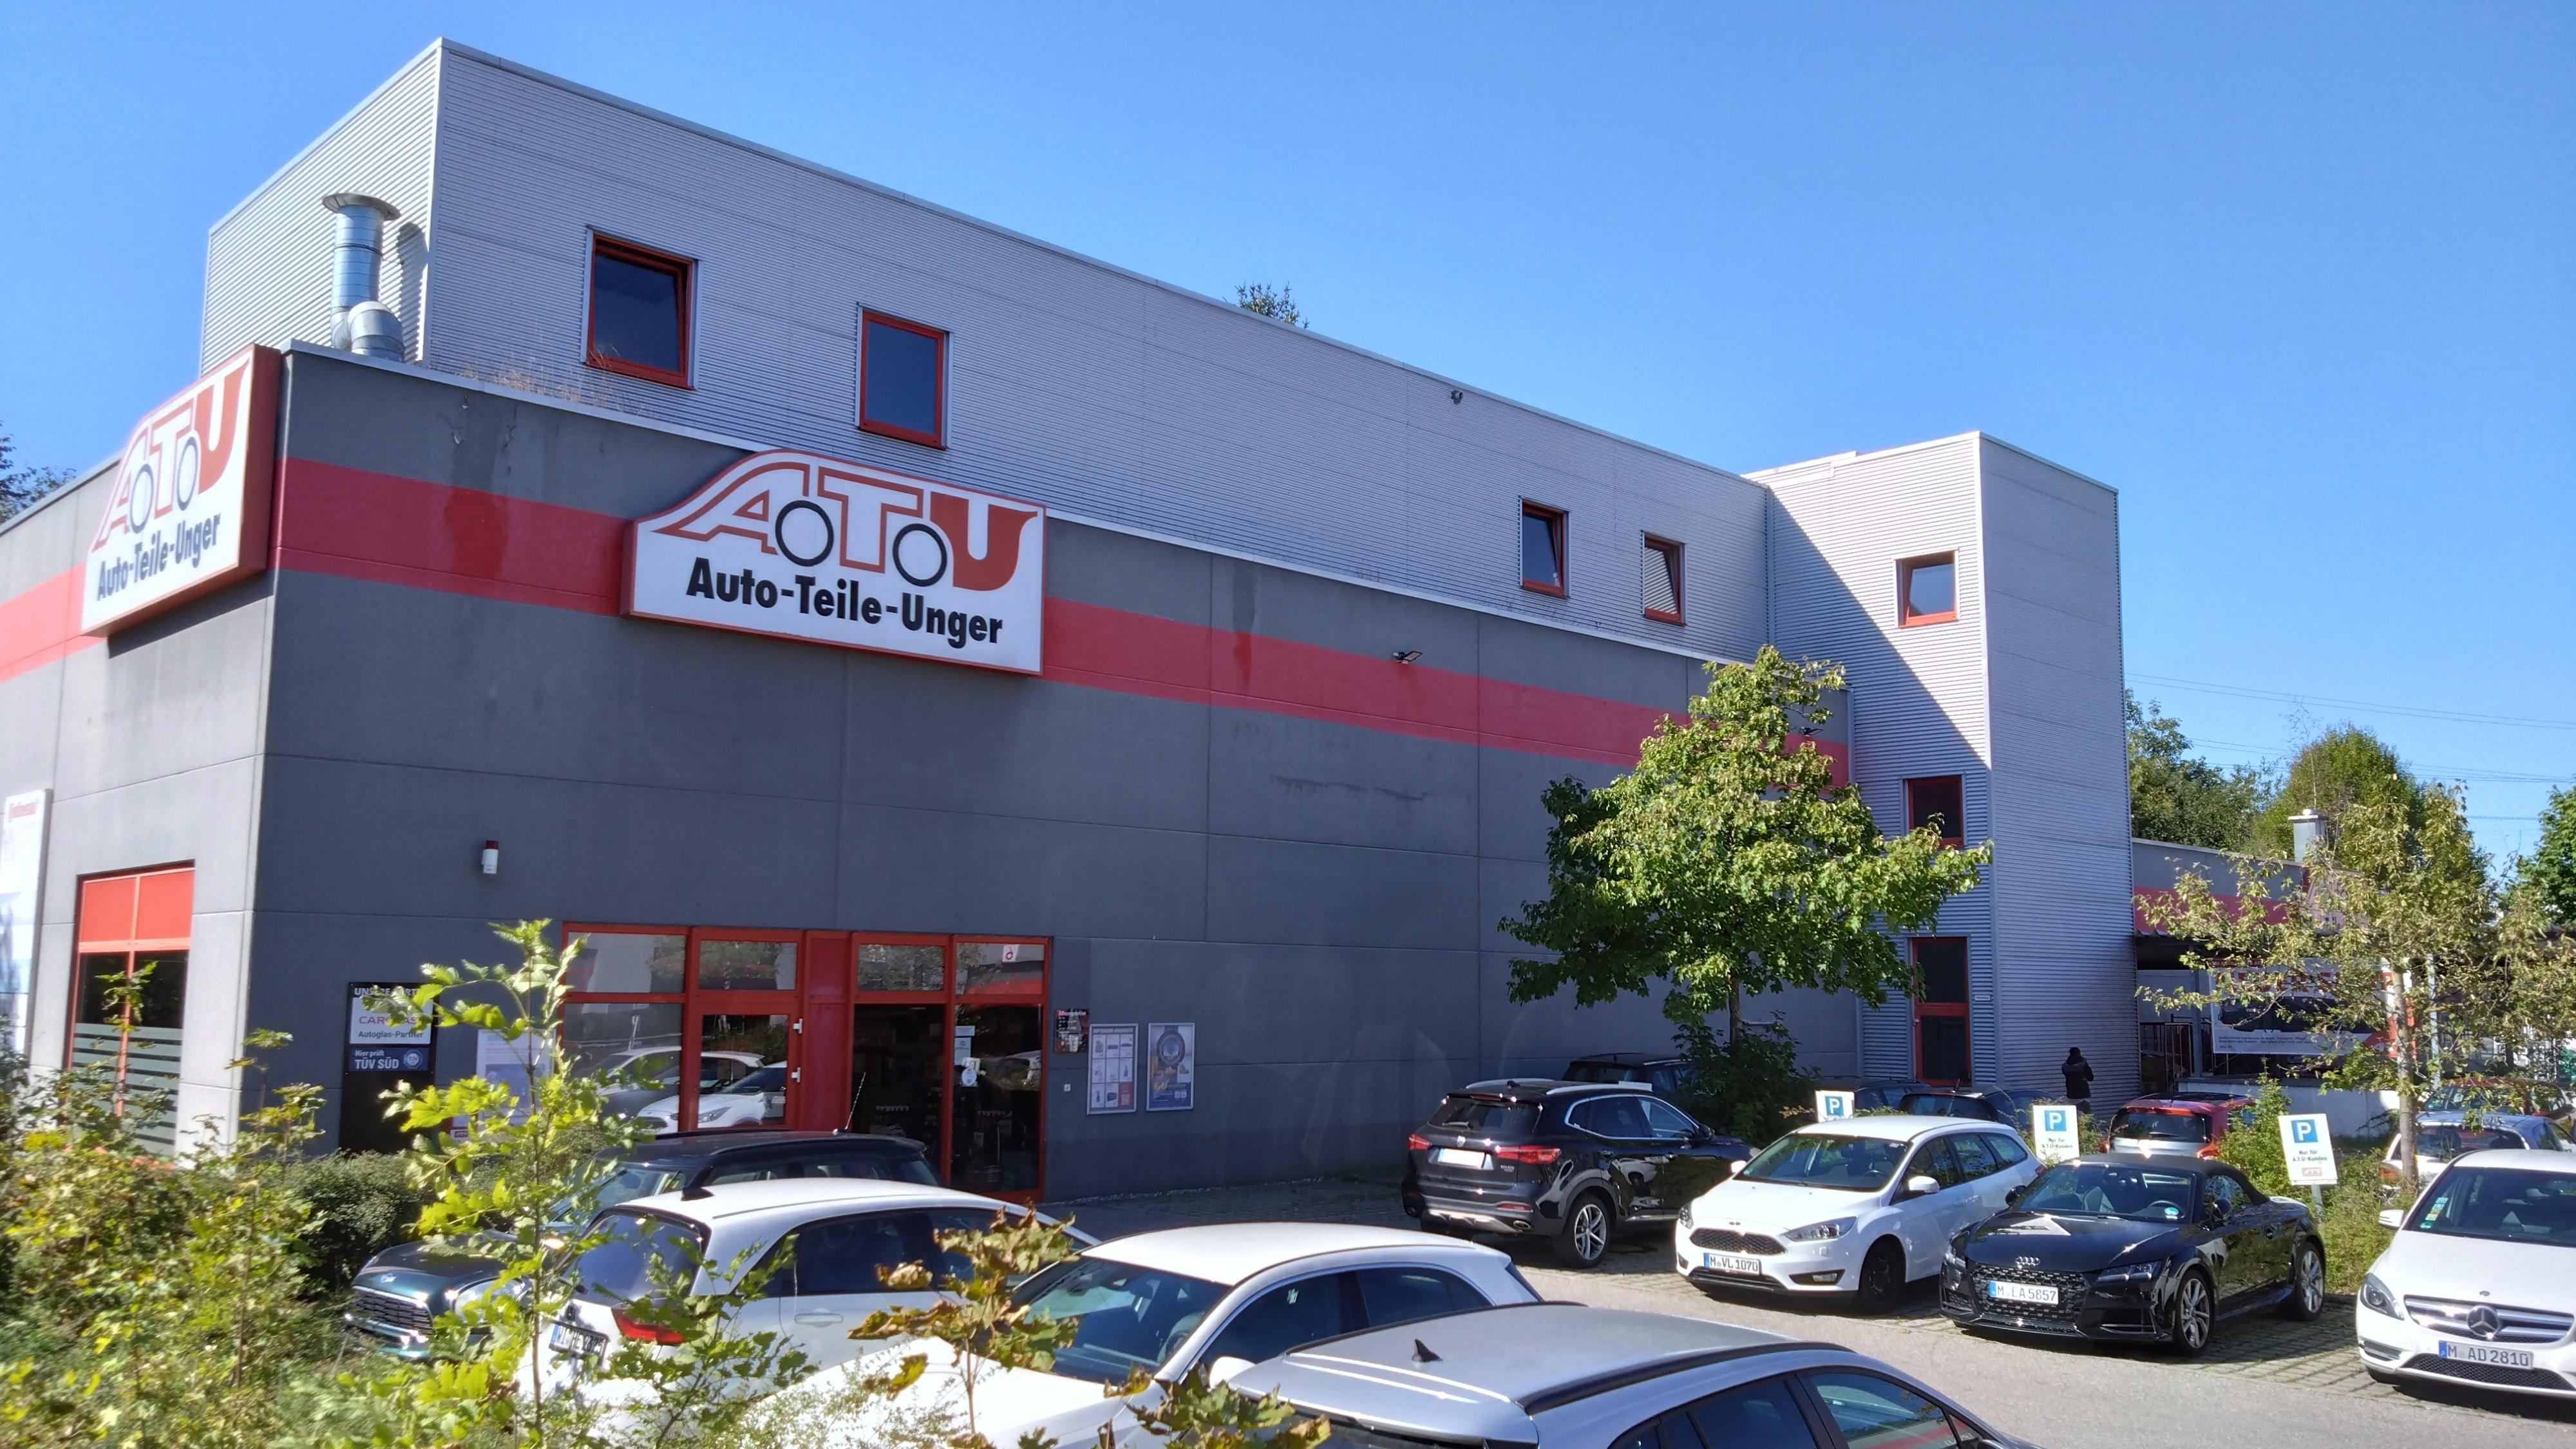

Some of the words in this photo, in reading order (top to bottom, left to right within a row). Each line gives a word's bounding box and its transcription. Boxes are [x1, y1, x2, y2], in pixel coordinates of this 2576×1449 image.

[97, 513, 221, 601] Auto-Teile-Unger
[686, 556, 1003, 649] Auto-Teile-Unger
[355, 1057, 376, 1069] TÜV
[377, 1057, 399, 1069] SÜD
[1829, 1097, 1840, 1114] P
[2049, 1112, 2062, 1130] P
[2297, 1122, 2312, 1141] P
[1710, 1256, 1716, 1267] M
[1721, 1257, 1734, 1269] VL
[1735, 1259, 1758, 1272] 1070
[1997, 1285, 2004, 1296] M
[2012, 1287, 2025, 1298] EA
[2028, 1288, 2056, 1301] 5857
[2447, 1344, 2457, 1358] M
[2468, 1347, 2486, 1361] AD
[2490, 1350, 2528, 1367] 2810
